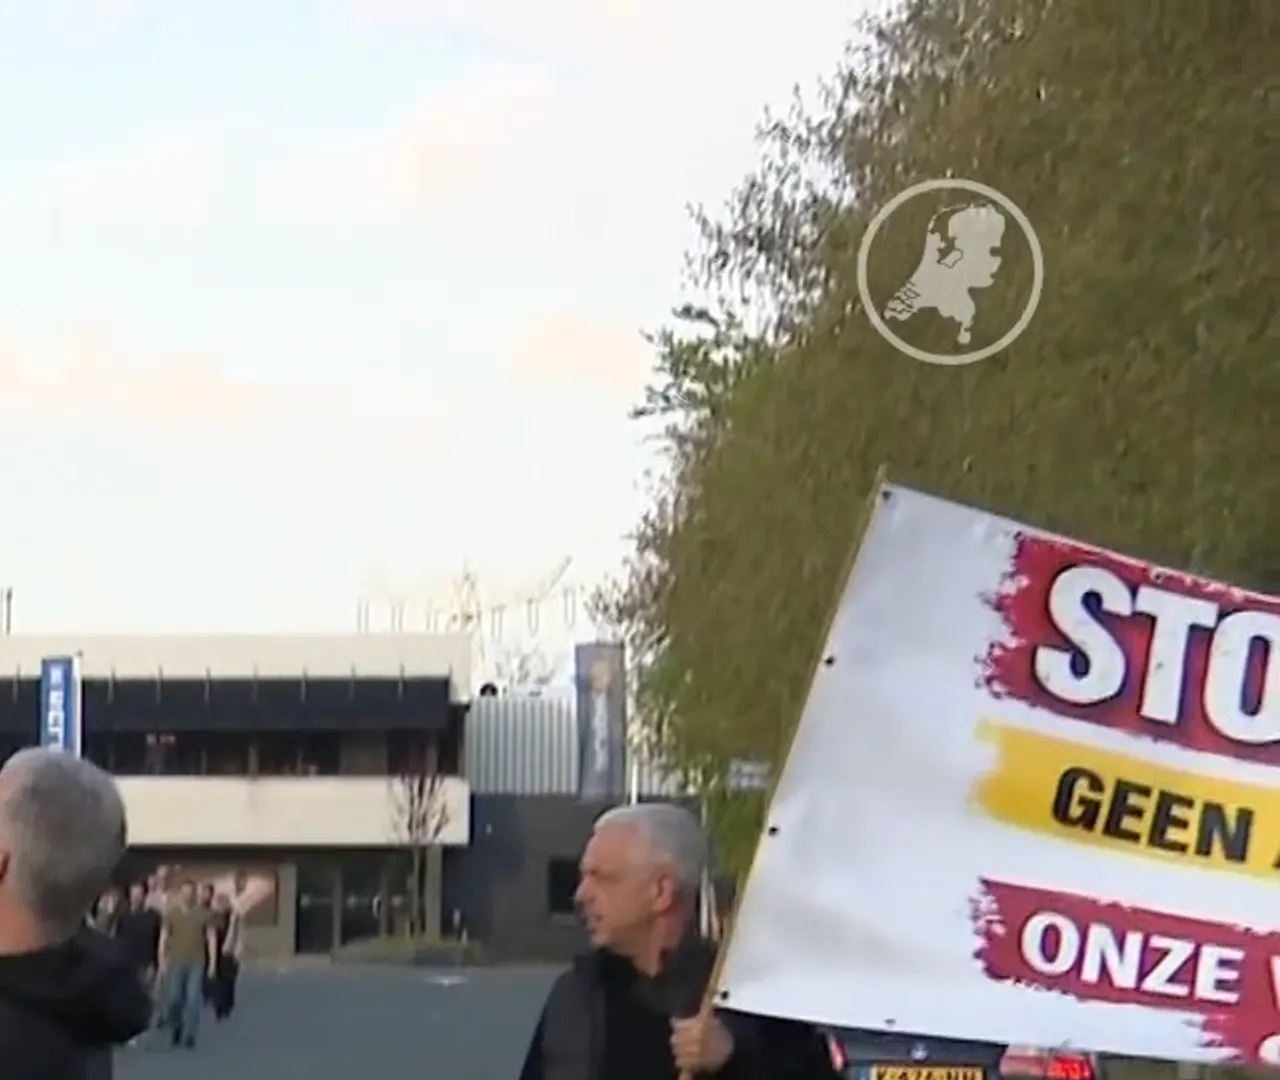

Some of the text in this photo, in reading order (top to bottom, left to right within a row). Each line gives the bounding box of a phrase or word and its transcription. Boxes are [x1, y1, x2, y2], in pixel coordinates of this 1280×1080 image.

[1034, 563, 1280, 745] STO
[1051, 766, 1255, 865] GEEN
[1020, 909, 1245, 1004] ONZE
